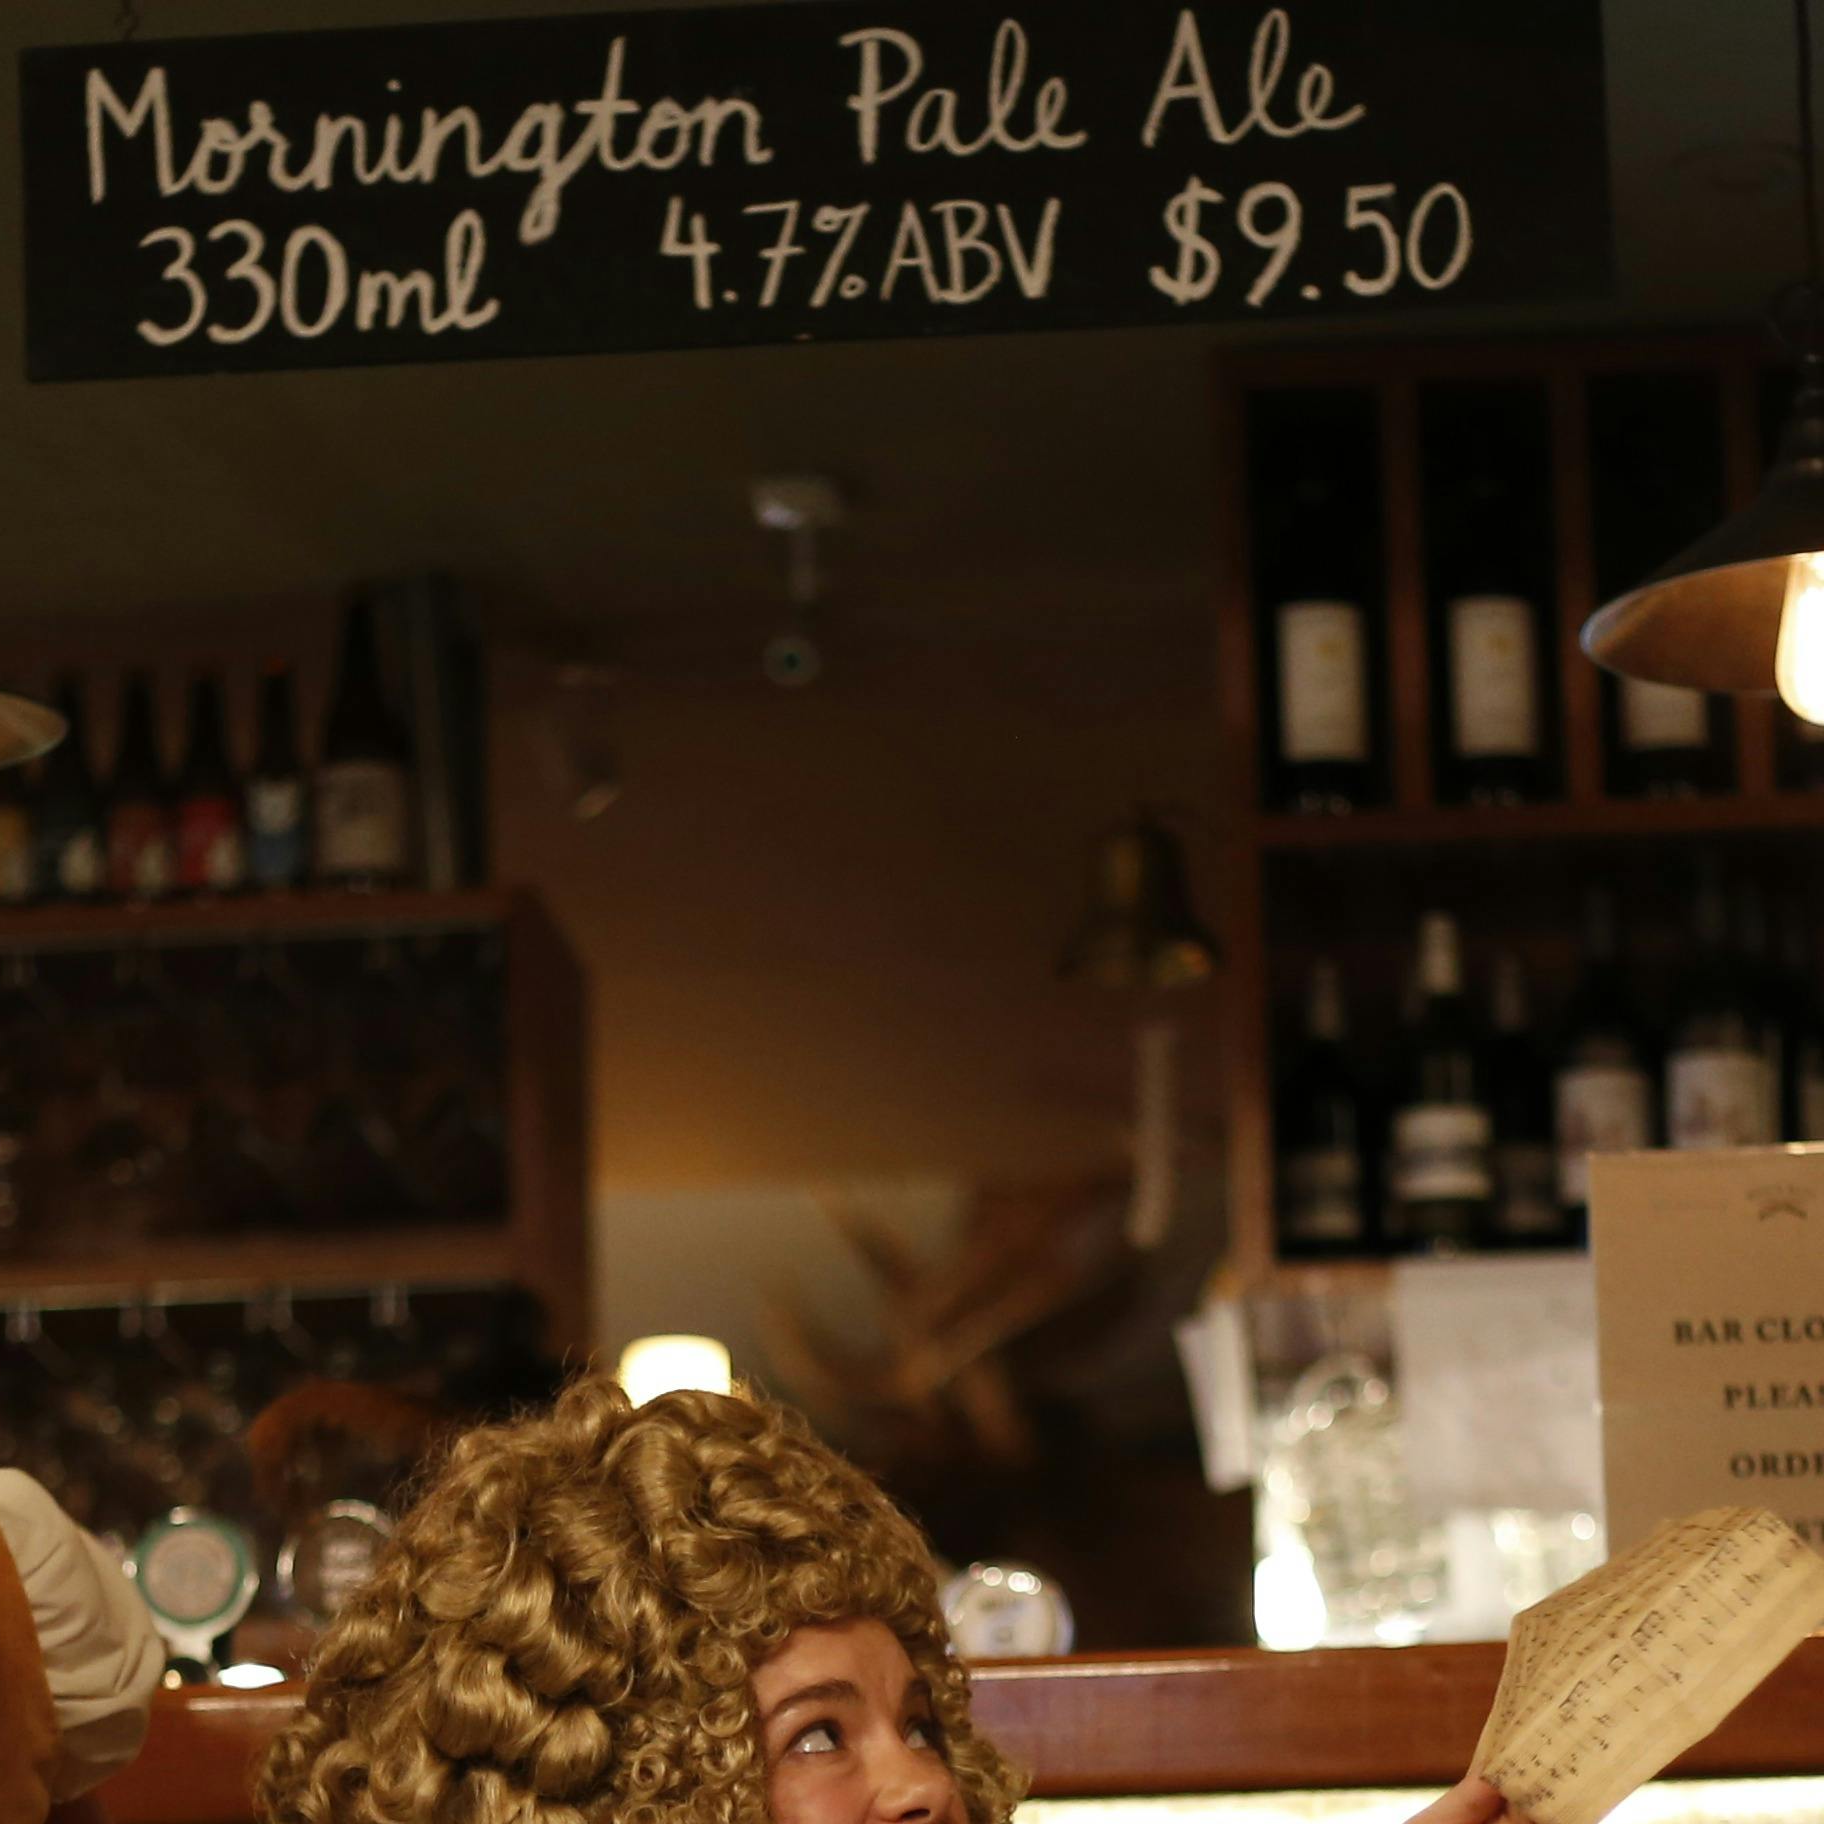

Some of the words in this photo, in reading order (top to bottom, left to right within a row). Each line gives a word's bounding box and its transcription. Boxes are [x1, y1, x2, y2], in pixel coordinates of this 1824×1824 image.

[84, 36, 775, 246] Mornington
[837, 18, 1089, 164] Pale
[1140, 7, 1367, 148] Ale
[135, 208, 501, 347] 330ml
[1148, 175, 1474, 308] $9.50
[1672, 1319, 1745, 1346] BAR
